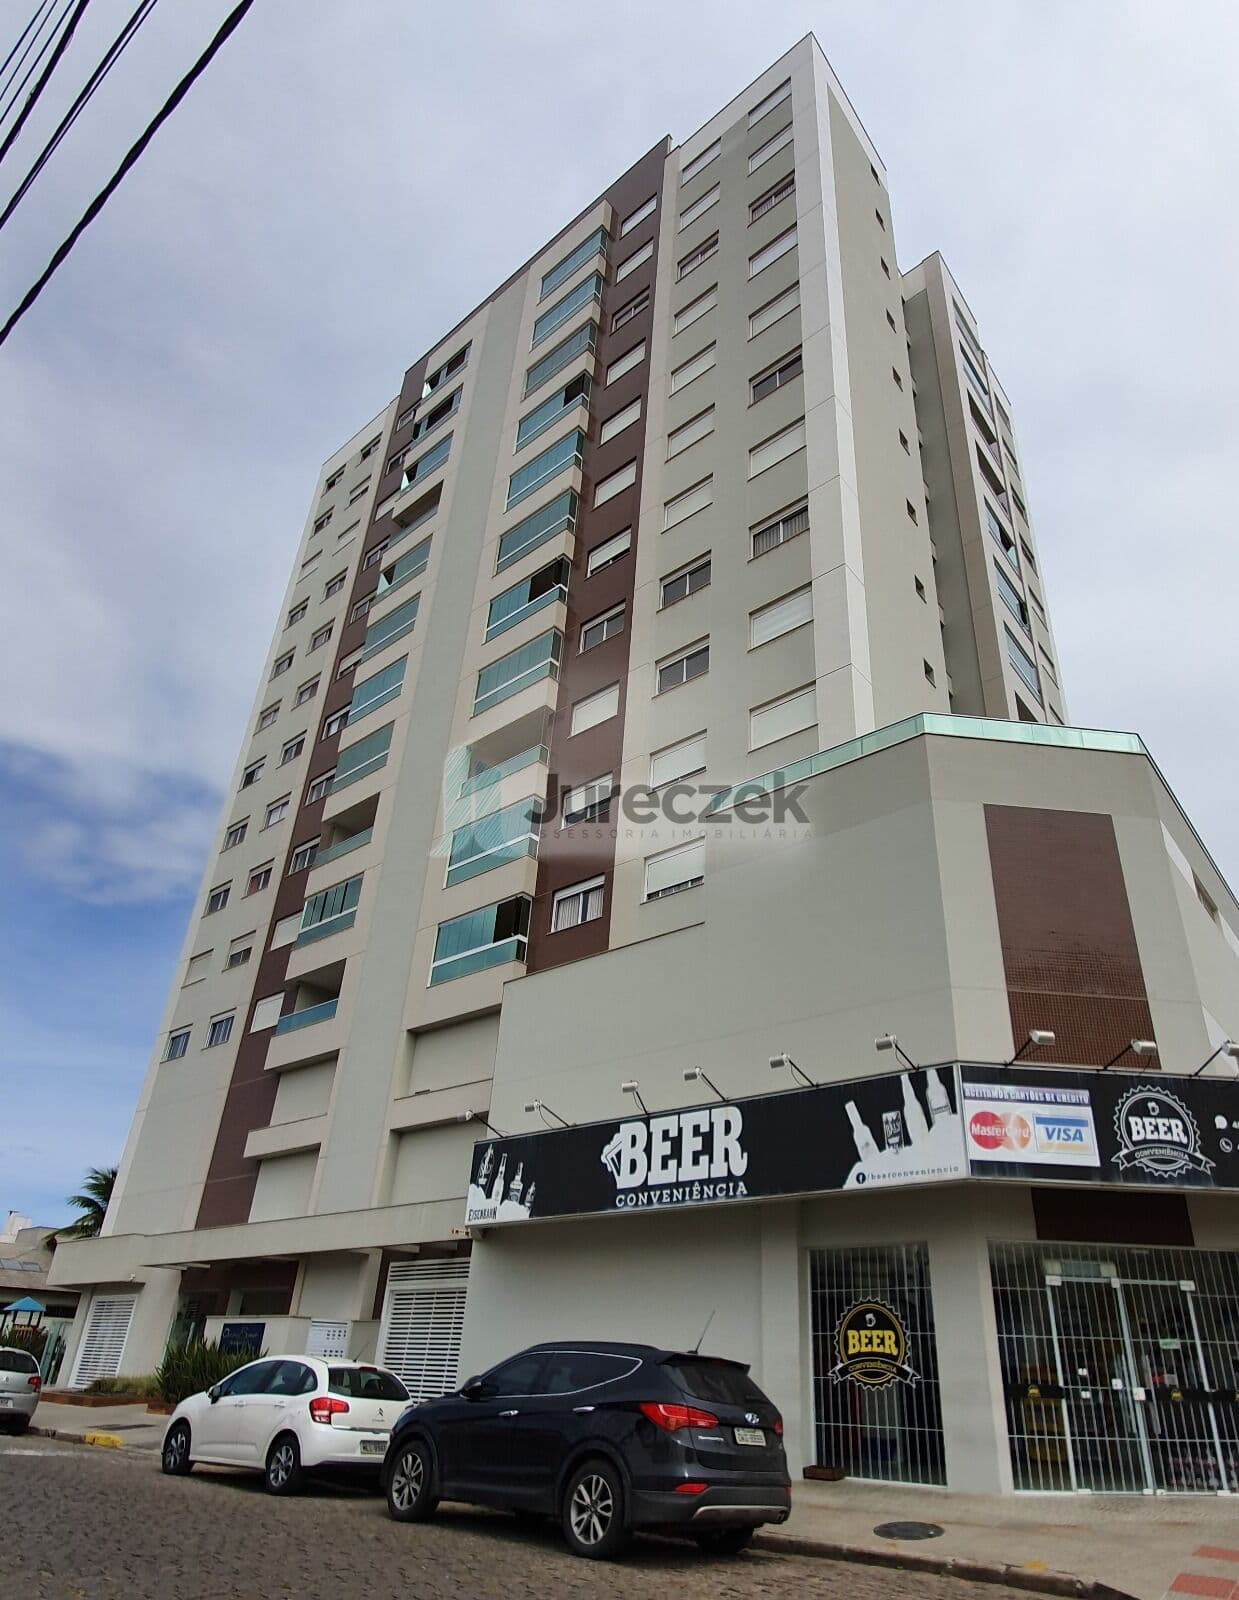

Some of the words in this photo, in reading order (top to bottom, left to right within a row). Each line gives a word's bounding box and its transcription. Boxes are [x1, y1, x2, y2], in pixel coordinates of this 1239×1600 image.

[1045, 1127, 1084, 1142] VISA
[1128, 1116, 1188, 1145] BEER
[616, 1105, 748, 1189] BEER
[616, 1180, 748, 1208] CONVENIÊNCIA
[847, 1329, 899, 1356] BEER
